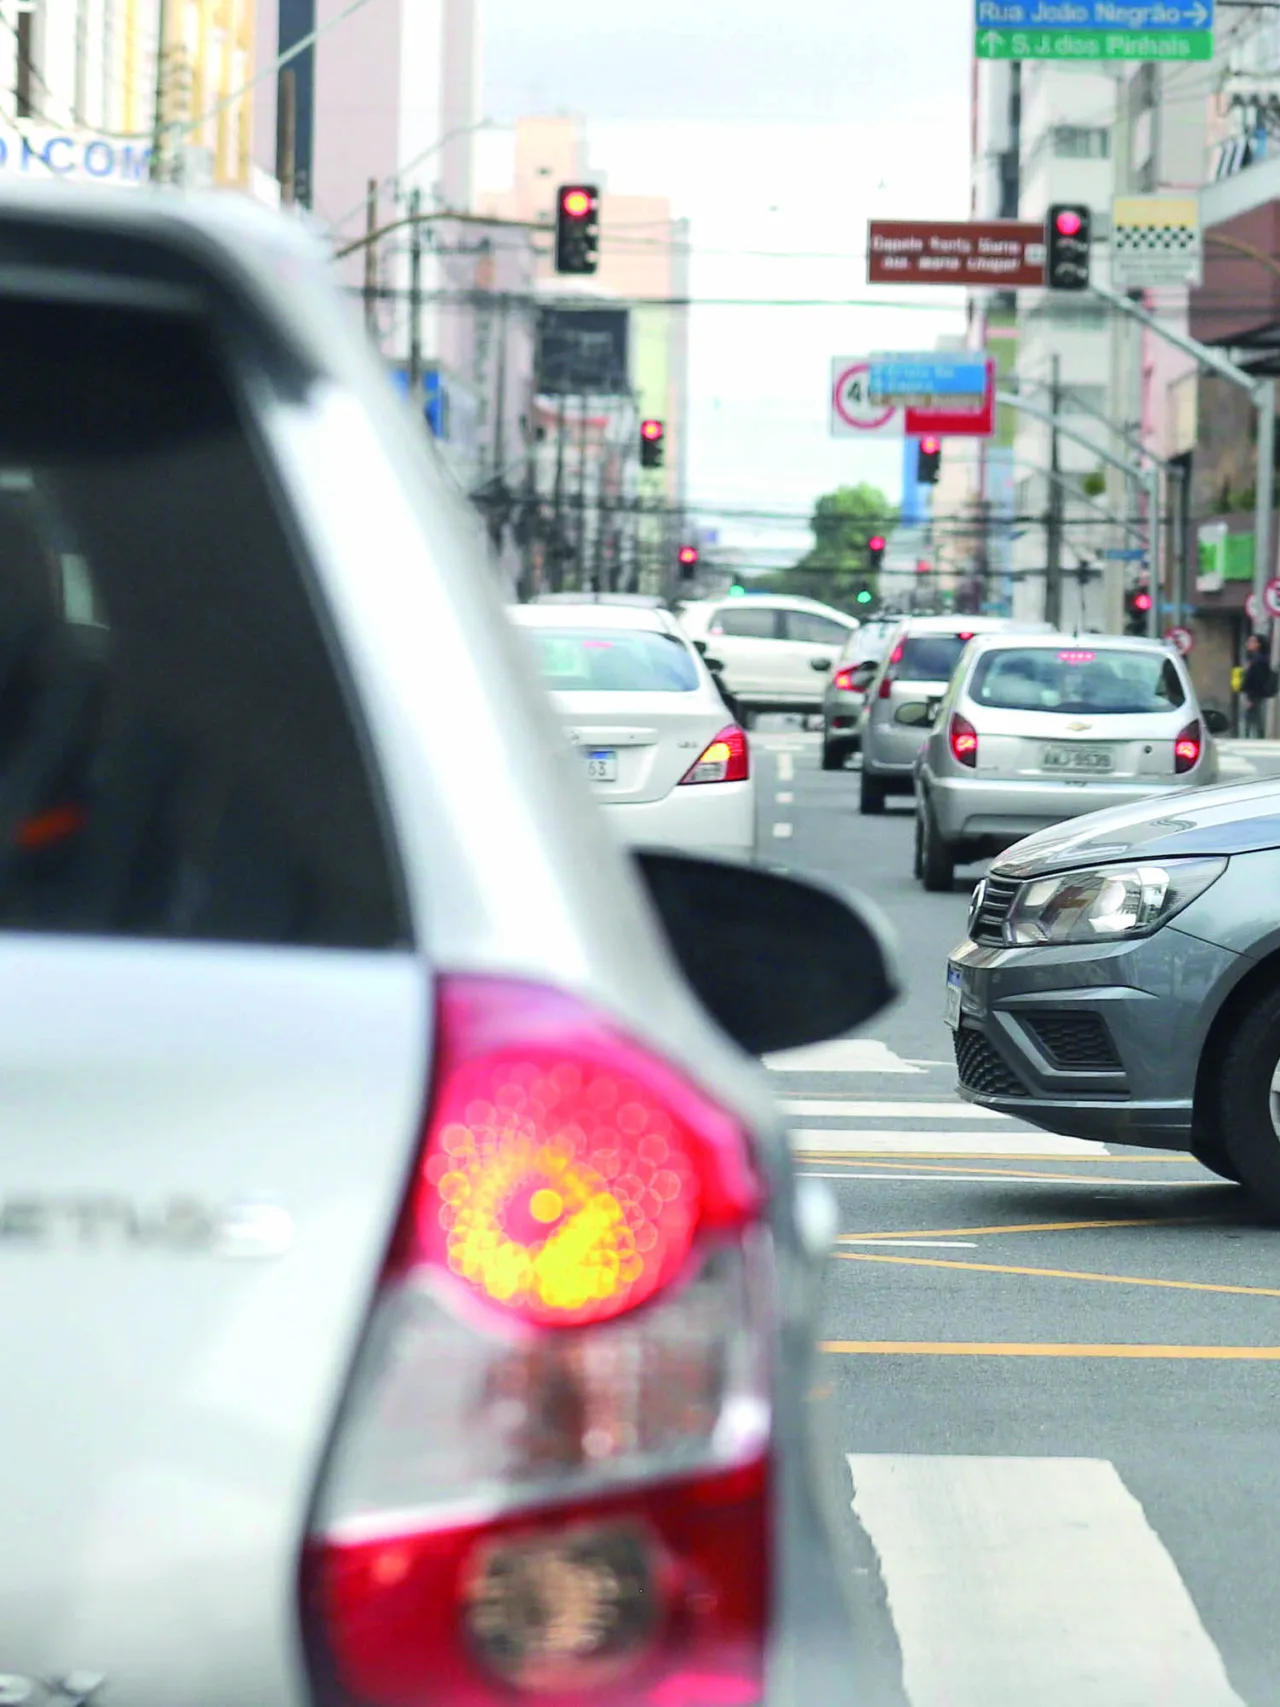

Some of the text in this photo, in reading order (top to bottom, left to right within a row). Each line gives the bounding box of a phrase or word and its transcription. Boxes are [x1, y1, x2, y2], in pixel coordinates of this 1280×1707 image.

[979, 0, 1181, 28] Rua João Negrão
[1105, 34, 1191, 56] Pinhais
